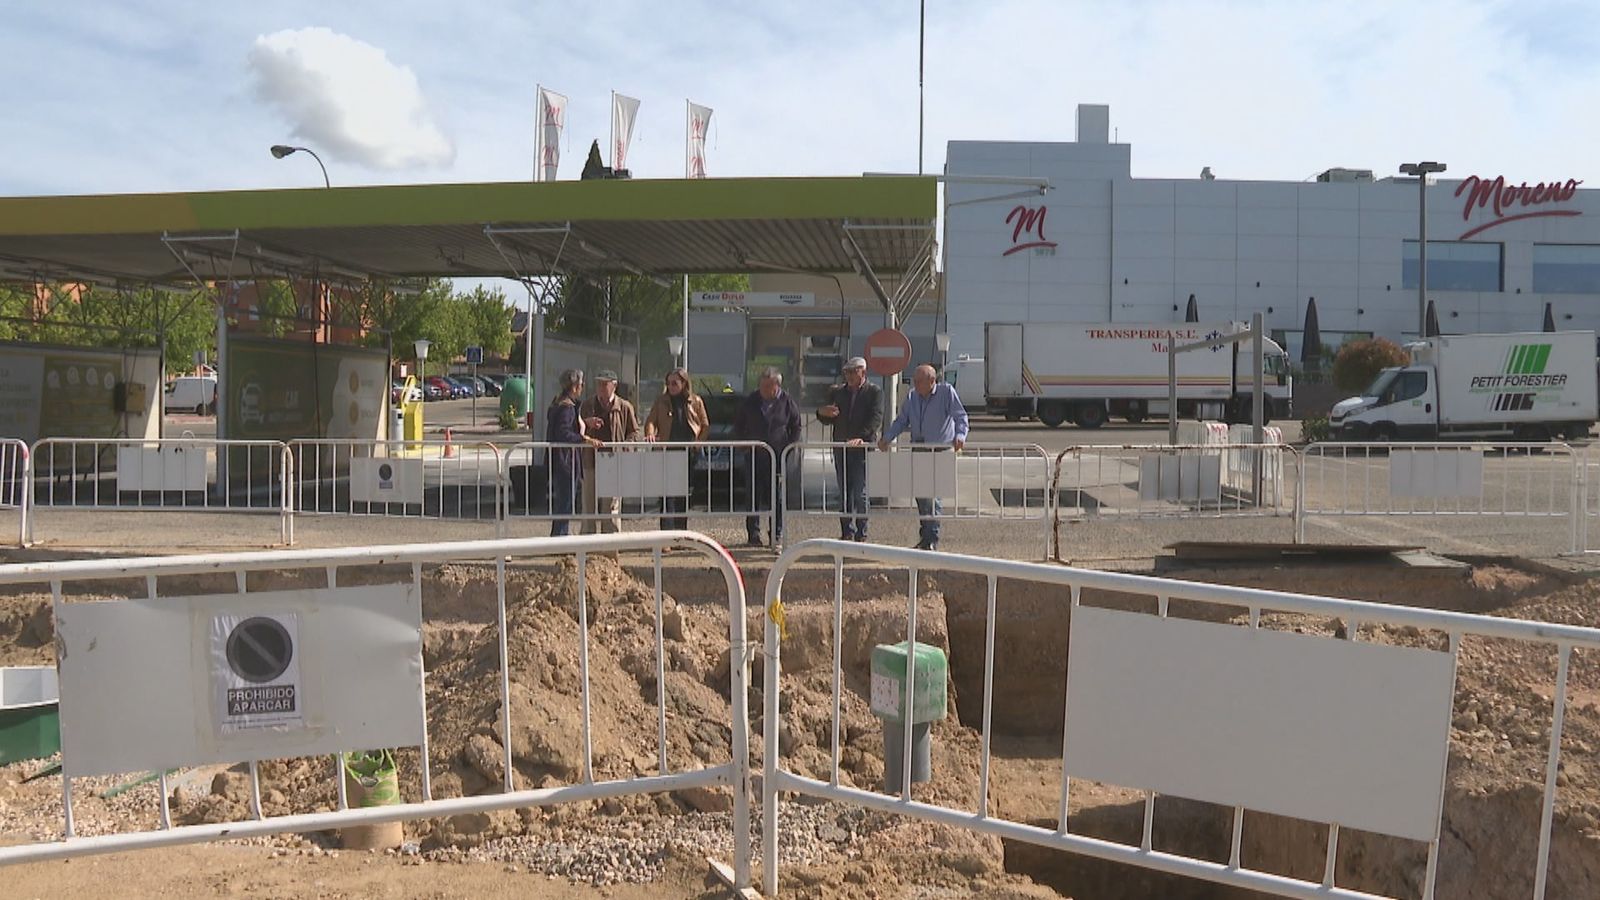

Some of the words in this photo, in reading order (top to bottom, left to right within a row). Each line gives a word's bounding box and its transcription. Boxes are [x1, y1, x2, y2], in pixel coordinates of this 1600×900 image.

[1455, 175, 1584, 221] Moreno
[1005, 205, 1047, 243] M
[1086, 329, 1172, 339] TRANSPEREA
[1471, 376, 1502, 388] PETIT
[1503, 374, 1567, 386] FORESTIER
[229, 688, 294, 702] PROHIBIDO
[232, 700, 291, 713] APARCAR
